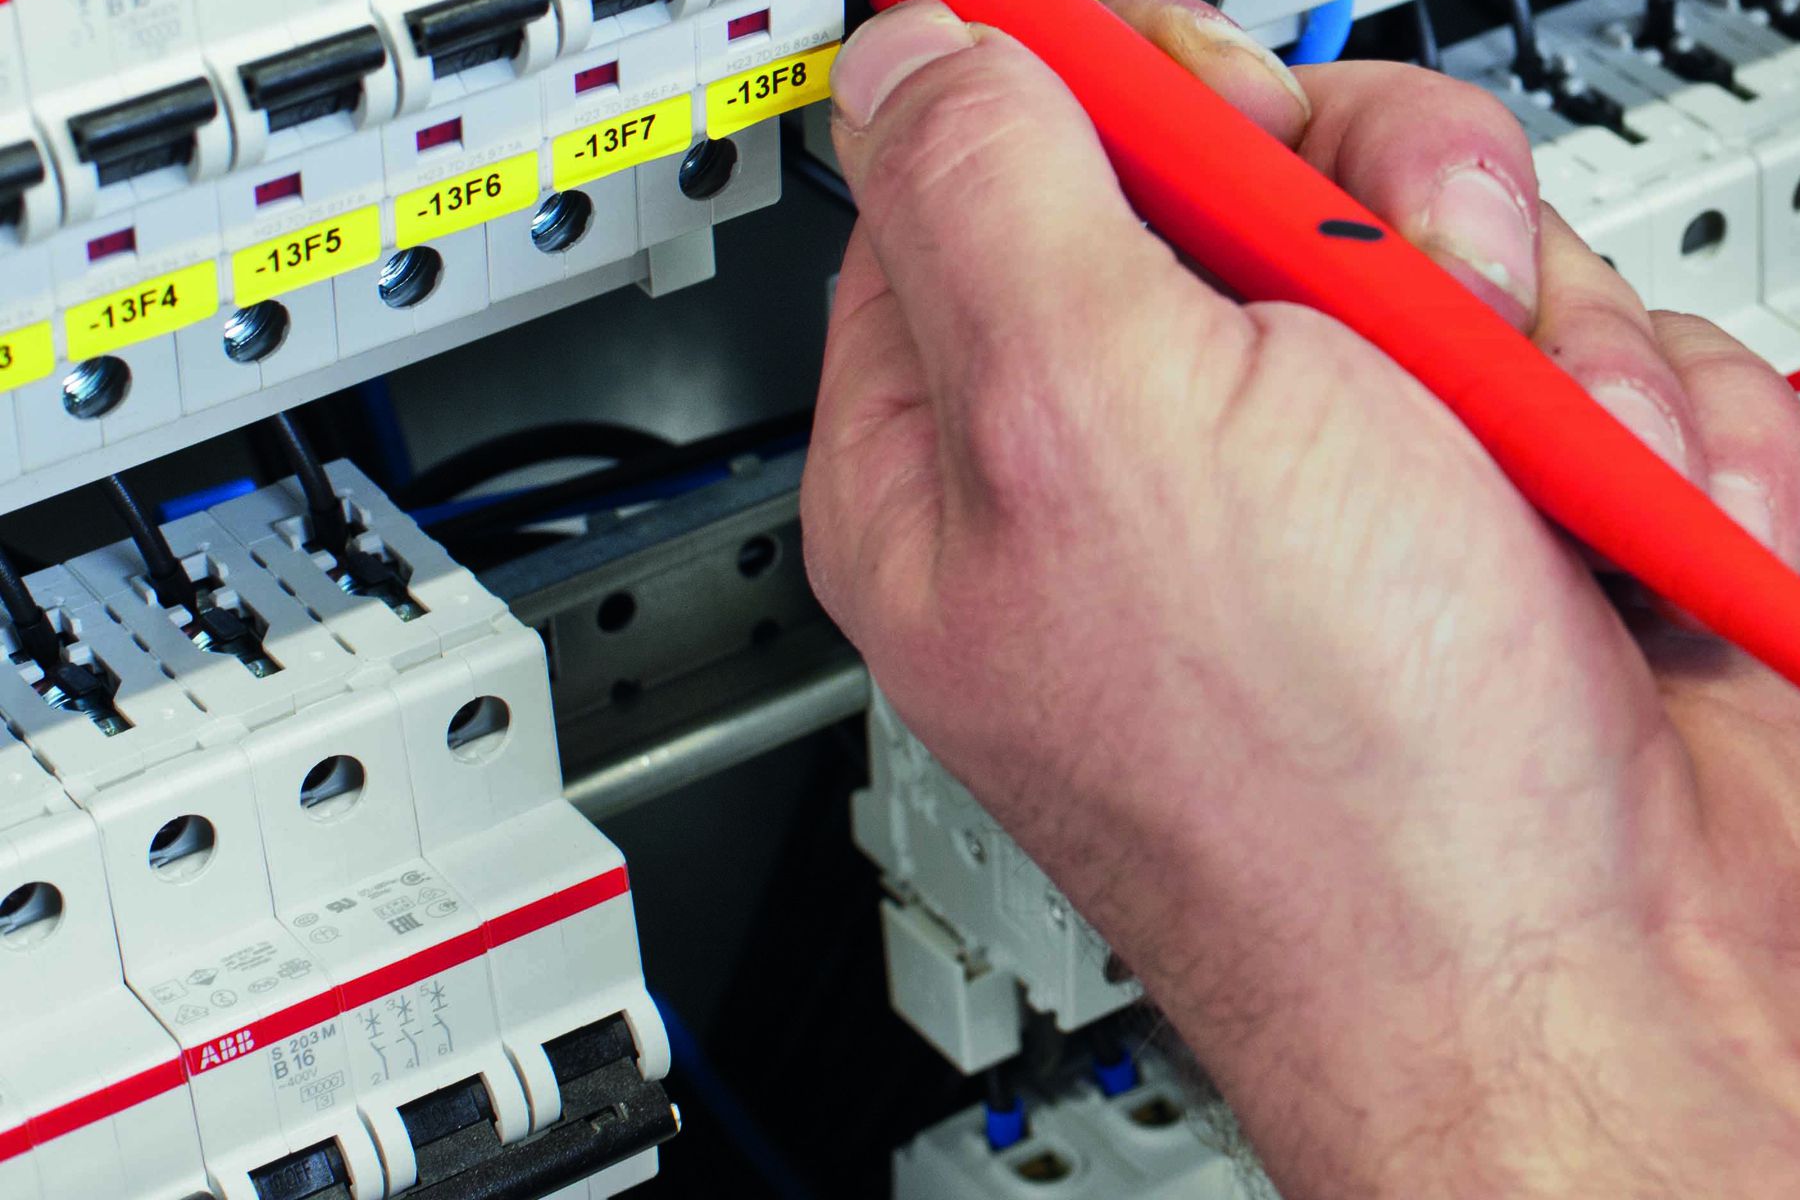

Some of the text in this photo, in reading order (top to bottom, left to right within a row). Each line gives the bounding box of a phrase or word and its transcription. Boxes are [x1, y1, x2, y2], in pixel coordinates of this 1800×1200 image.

[726, 61, 807, 106] -13F8
[574, 114, 656, 160] -13F7
[418, 173, 502, 218] -13F6
[255, 227, 342, 275] -13F5
[89, 284, 179, 331] -13F4
[201, 1029, 254, 1069] ABB
[272, 1046, 282, 1061] S
[274, 1049, 315, 1080] B 16
